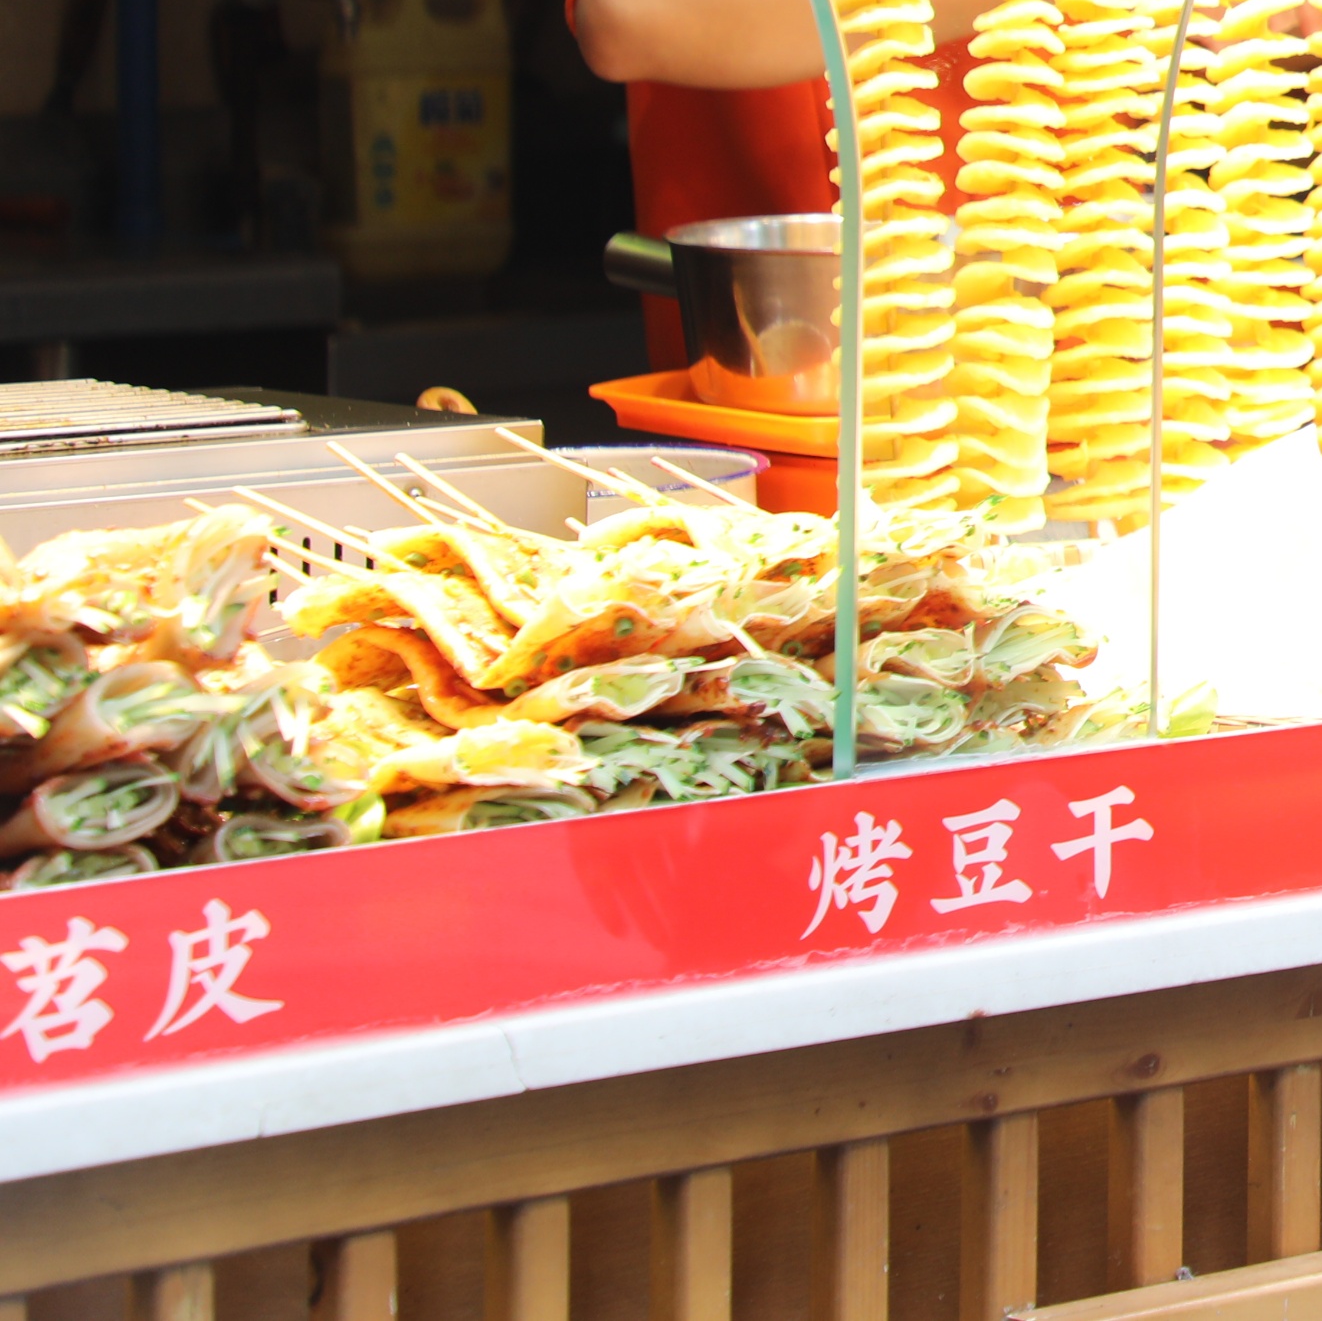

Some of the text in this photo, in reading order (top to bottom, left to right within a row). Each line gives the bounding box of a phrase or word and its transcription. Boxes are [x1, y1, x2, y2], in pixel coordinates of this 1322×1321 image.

[800, 785, 1154, 940] 烤豆干
[0, 898, 285, 1064] 苕皮
